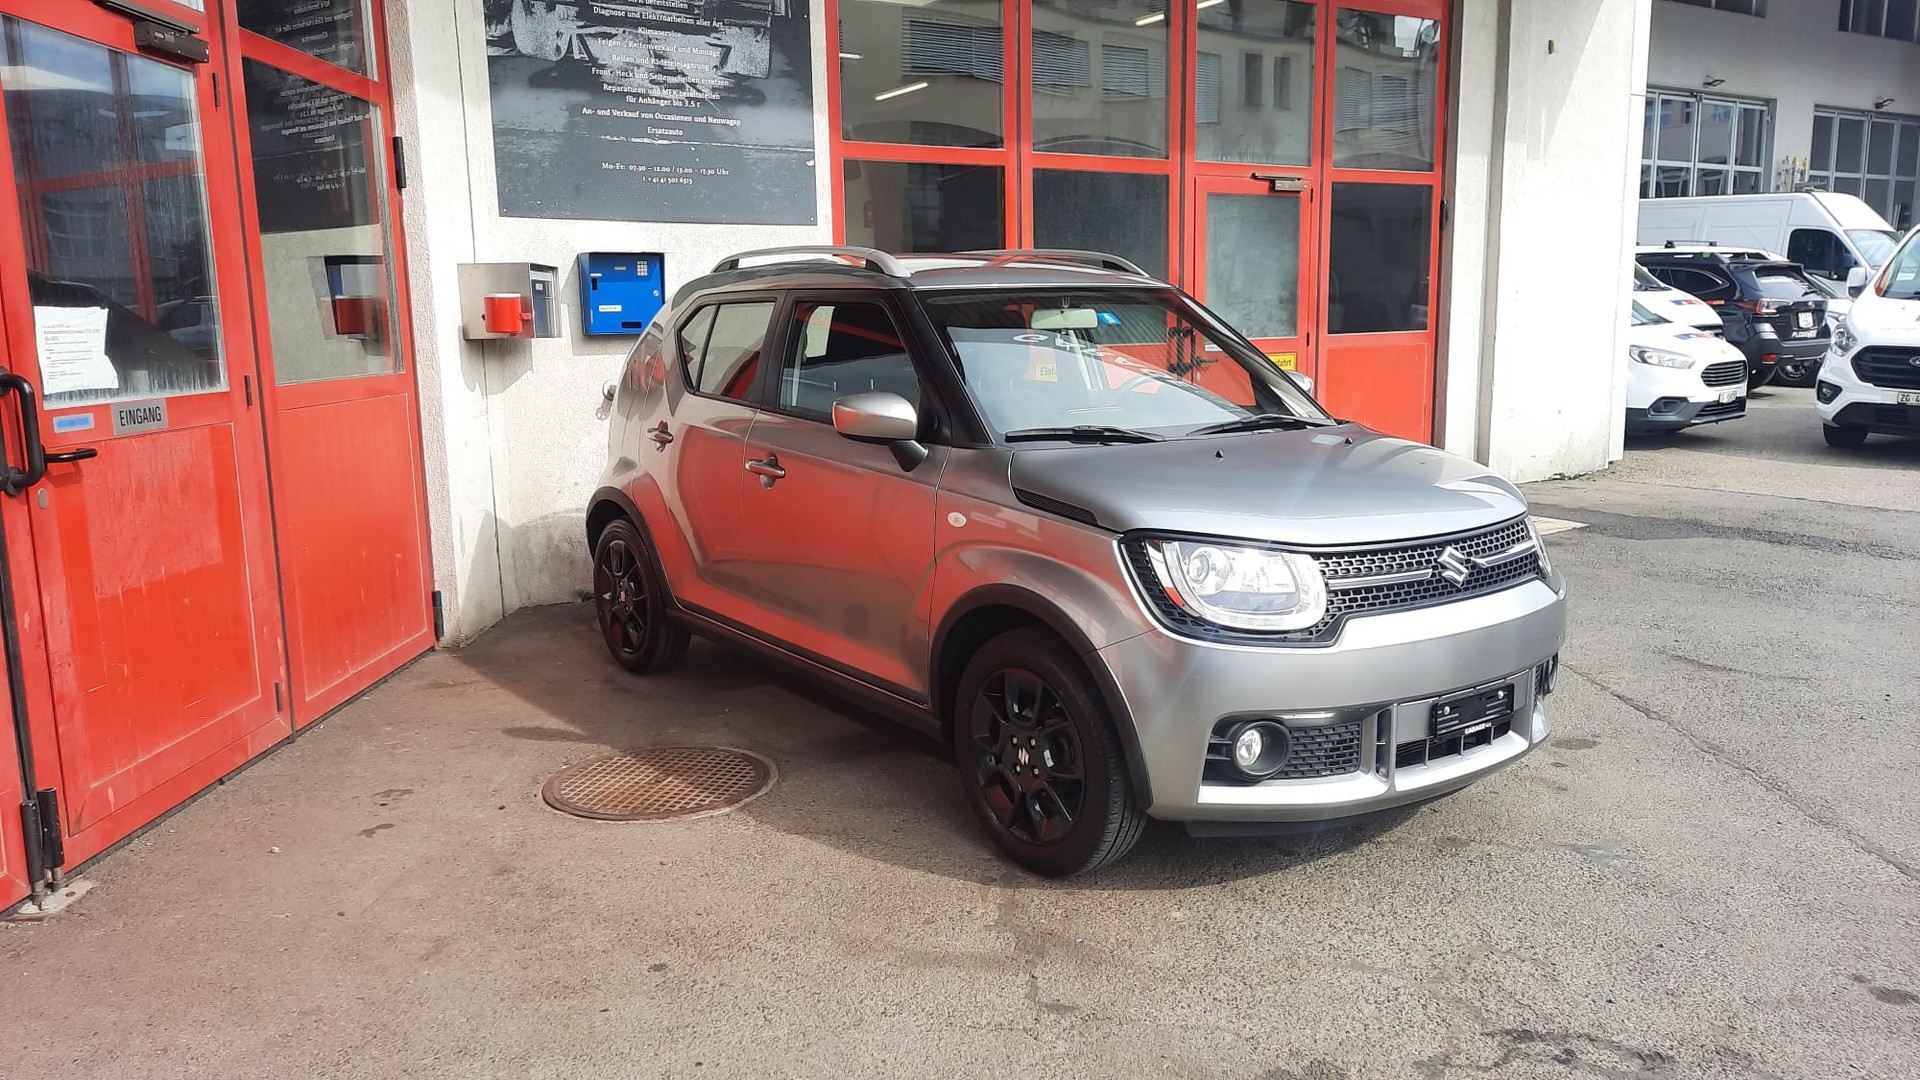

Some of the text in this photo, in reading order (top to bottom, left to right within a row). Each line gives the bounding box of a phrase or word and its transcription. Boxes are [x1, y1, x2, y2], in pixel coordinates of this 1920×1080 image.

[593, 7, 626, 18] Diagnose
[642, 12, 694, 24] Elektroarbeiten
[696, 18, 711, 26] aller
[638, 26, 681, 37] Klimaservice
[628, 41, 676, 52] Reifenverkauf
[692, 48, 721, 58] Montage
[612, 54, 635, 62] Reifen
[636, 56, 649, 64] und
[616, 69, 632, 78] Heck
[650, 73, 700, 84] Seitenscheiben
[604, 84, 646, 93] Reparaturen
[648, 87, 660, 95] und
[638, 97, 670, 106] Anhänger
[597, 108, 610, 116] und
[612, 109, 640, 118] Verkauf
[655, 112, 692, 122] Occasionen
[708, 116, 742, 126] Neuwagen
[648, 126, 684, 136] Ersatzauto
[1274, 358, 1292, 367] fahrt
[1900, 394, 1910, 402] ZG
[120, 406, 162, 426] EINGANG
